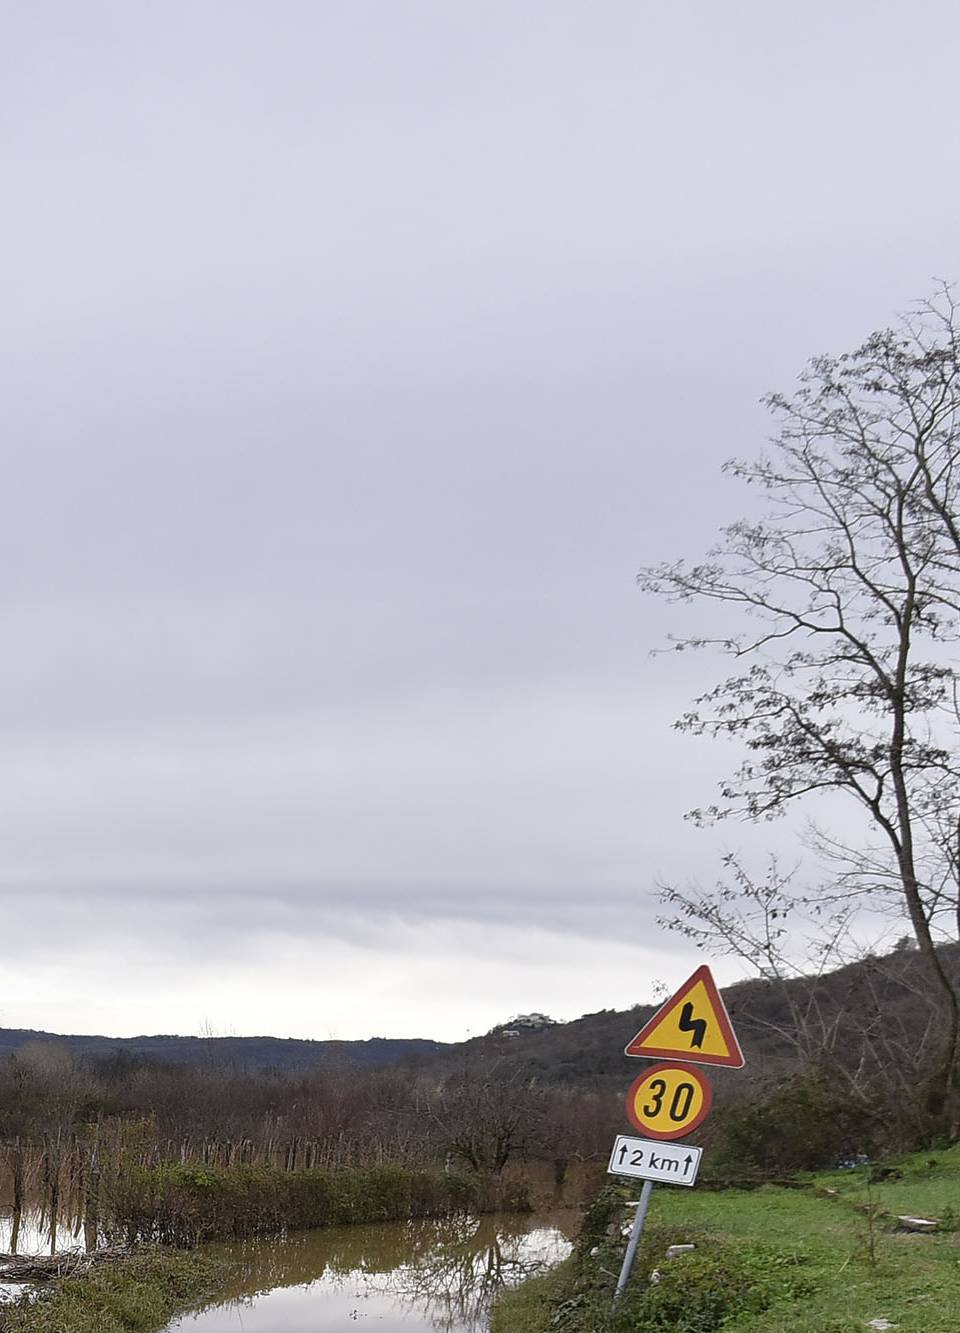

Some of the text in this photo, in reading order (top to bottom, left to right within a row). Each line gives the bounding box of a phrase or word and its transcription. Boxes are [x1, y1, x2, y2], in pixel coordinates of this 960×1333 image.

[643, 1079, 695, 1122] 30
[630, 1149, 680, 1172] 2 km
